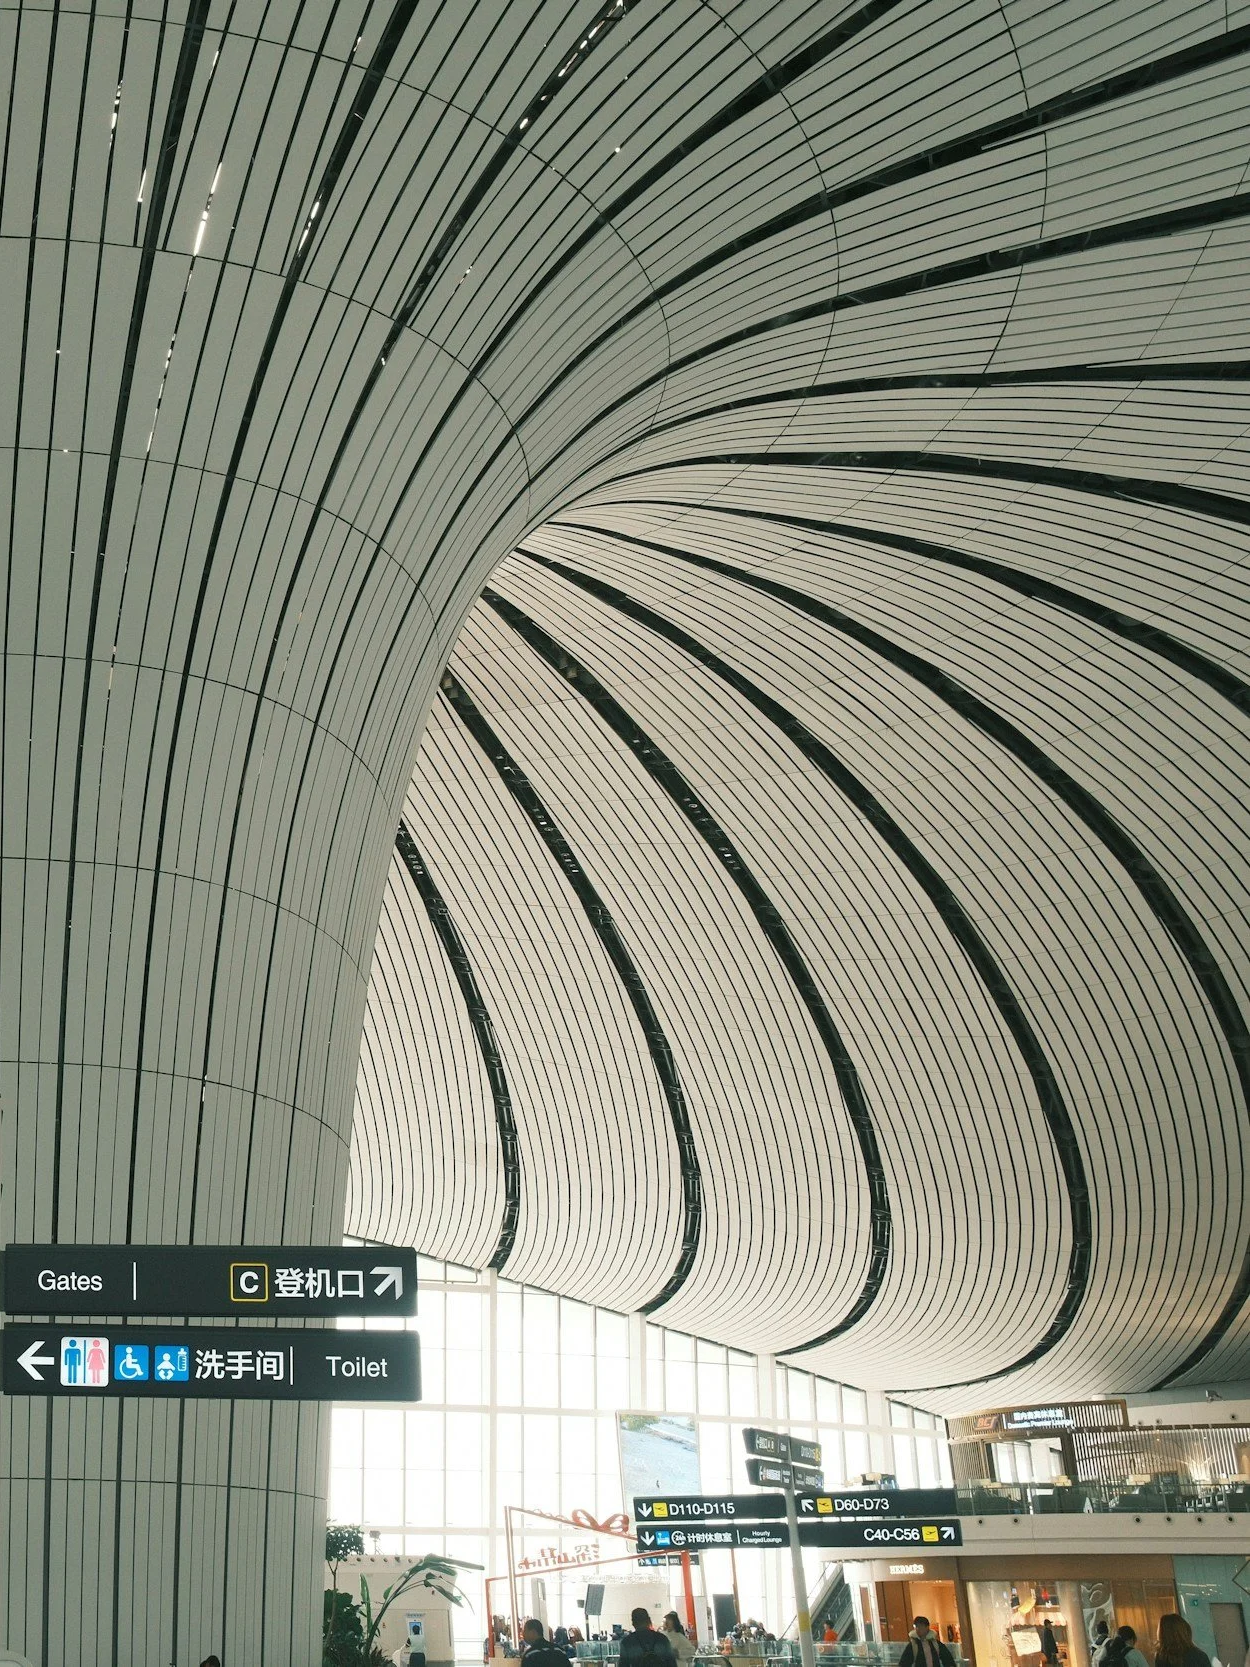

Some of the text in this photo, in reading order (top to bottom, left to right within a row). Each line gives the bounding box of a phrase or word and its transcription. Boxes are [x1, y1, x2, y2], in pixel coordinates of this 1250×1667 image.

[37, 1269, 103, 1292] Gates
[239, 1271, 259, 1294] C
[274, 1268, 364, 1298] 登机口
[195, 1349, 284, 1381] 洗手间
[325, 1356, 388, 1378] Toilet
[669, 1502, 735, 1516] D110-D115
[835, 1498, 890, 1511] D60-D73
[687, 1531, 733, 1543] 计时休息室
[742, 1536, 783, 1545] Charged Lounge
[752, 1530, 771, 1538] Hourly
[863, 1527, 921, 1541] C40-C56
